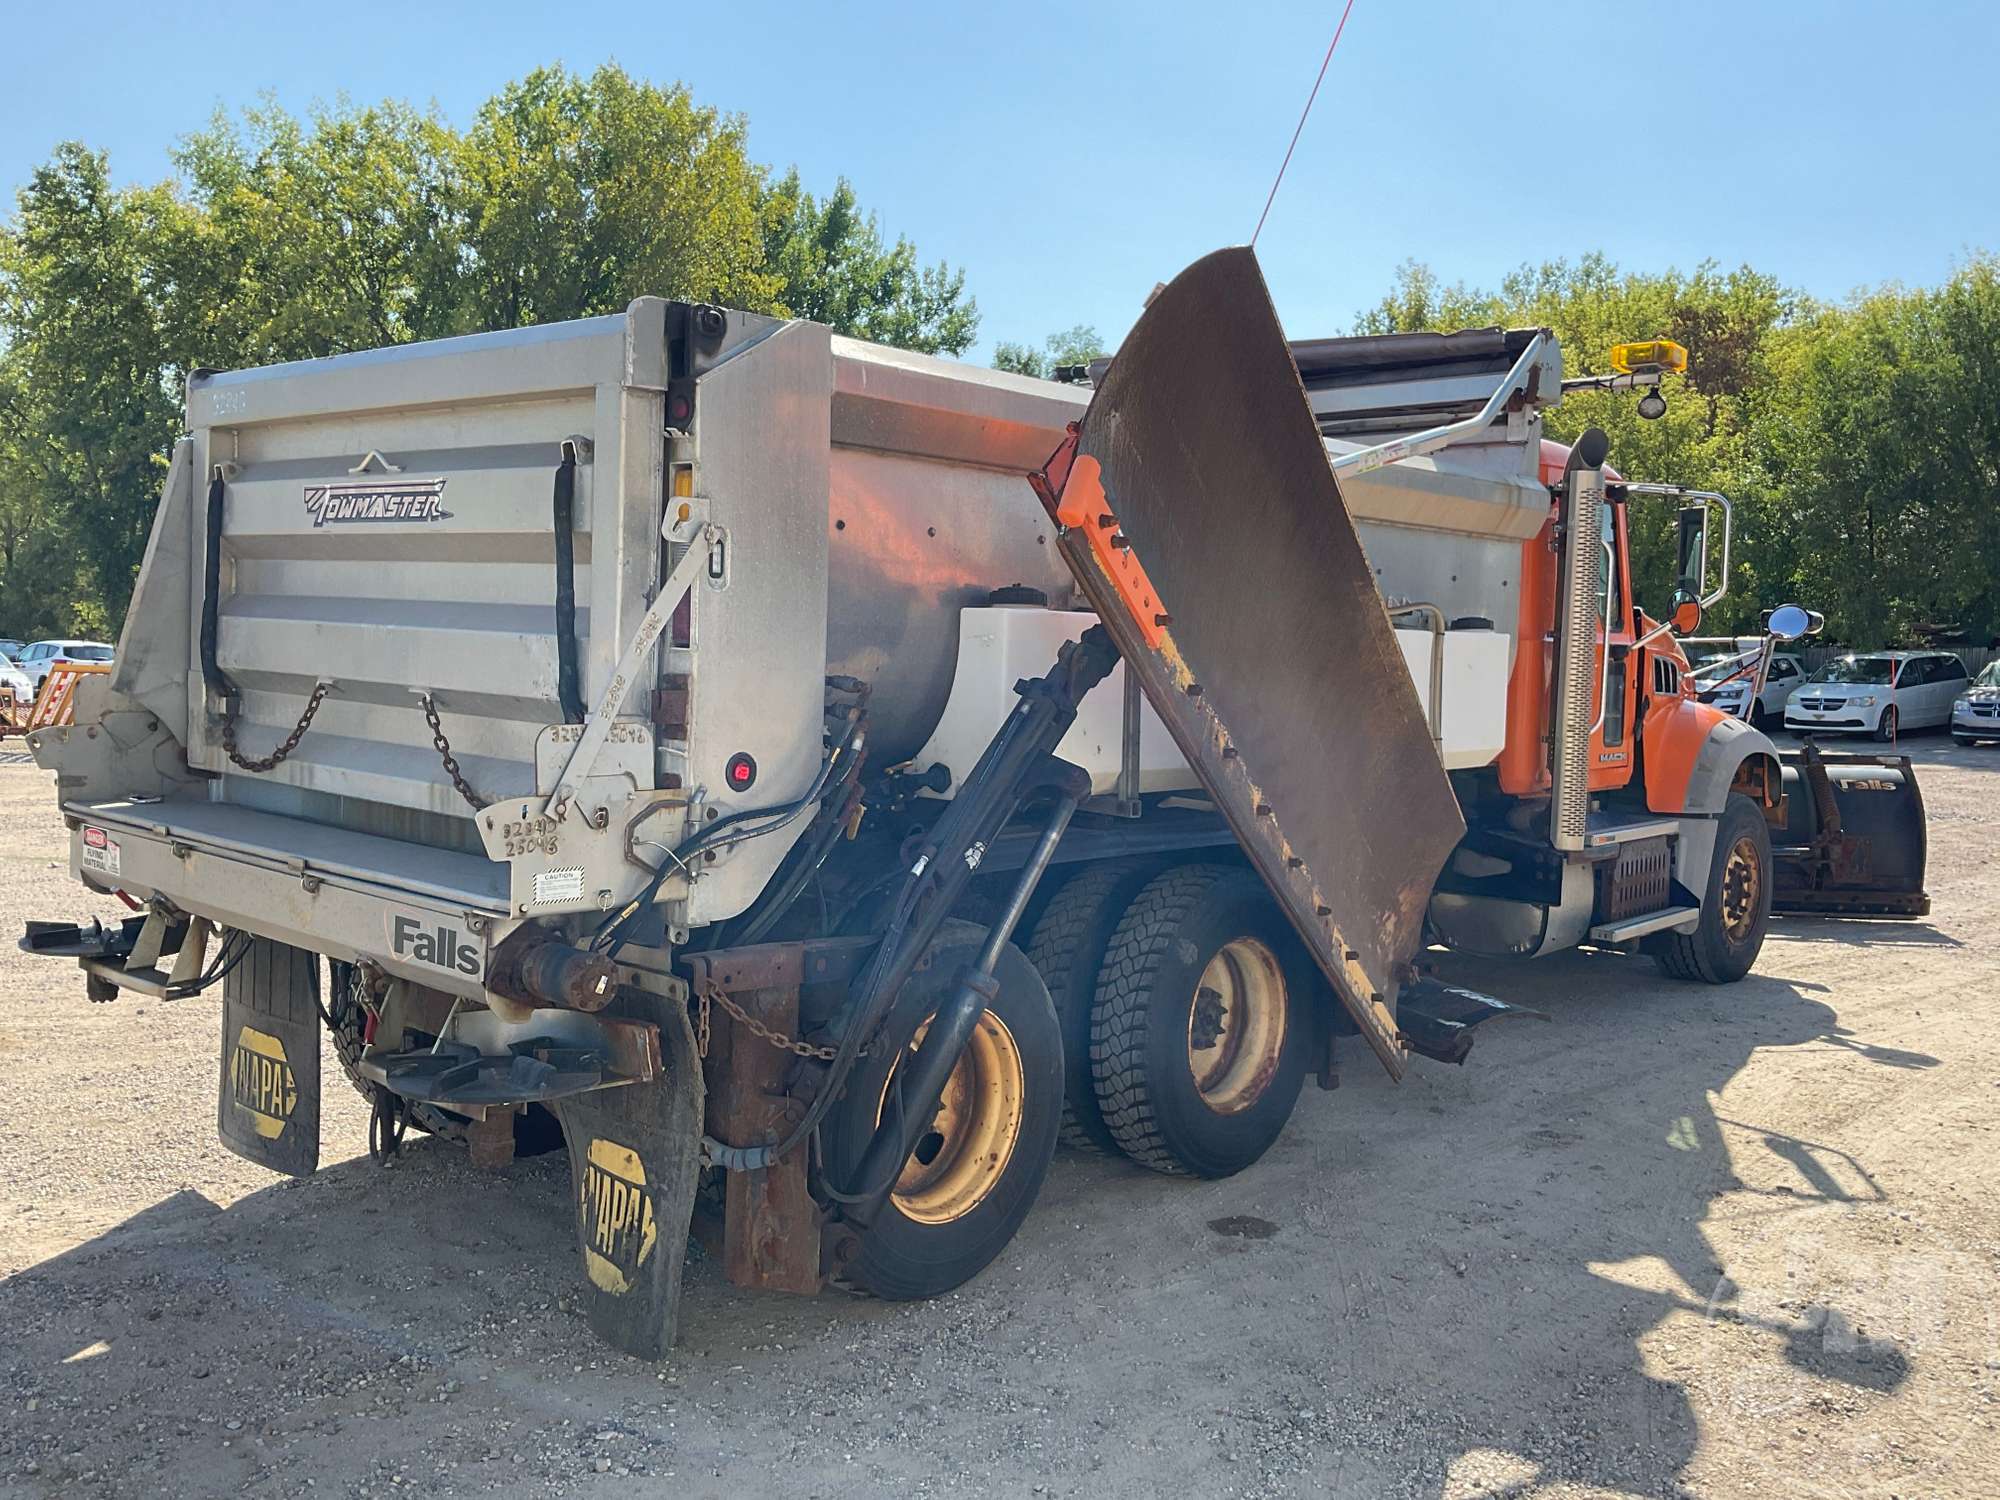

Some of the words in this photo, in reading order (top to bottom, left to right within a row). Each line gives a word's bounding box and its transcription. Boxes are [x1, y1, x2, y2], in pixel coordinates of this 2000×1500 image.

[304, 479, 447, 527] TOWMASTER
[87, 848, 103, 860] FLYING
[544, 872, 574, 881] CAUTION
[394, 915, 480, 976] Falls
[238, 1049, 283, 1117] NAPA
